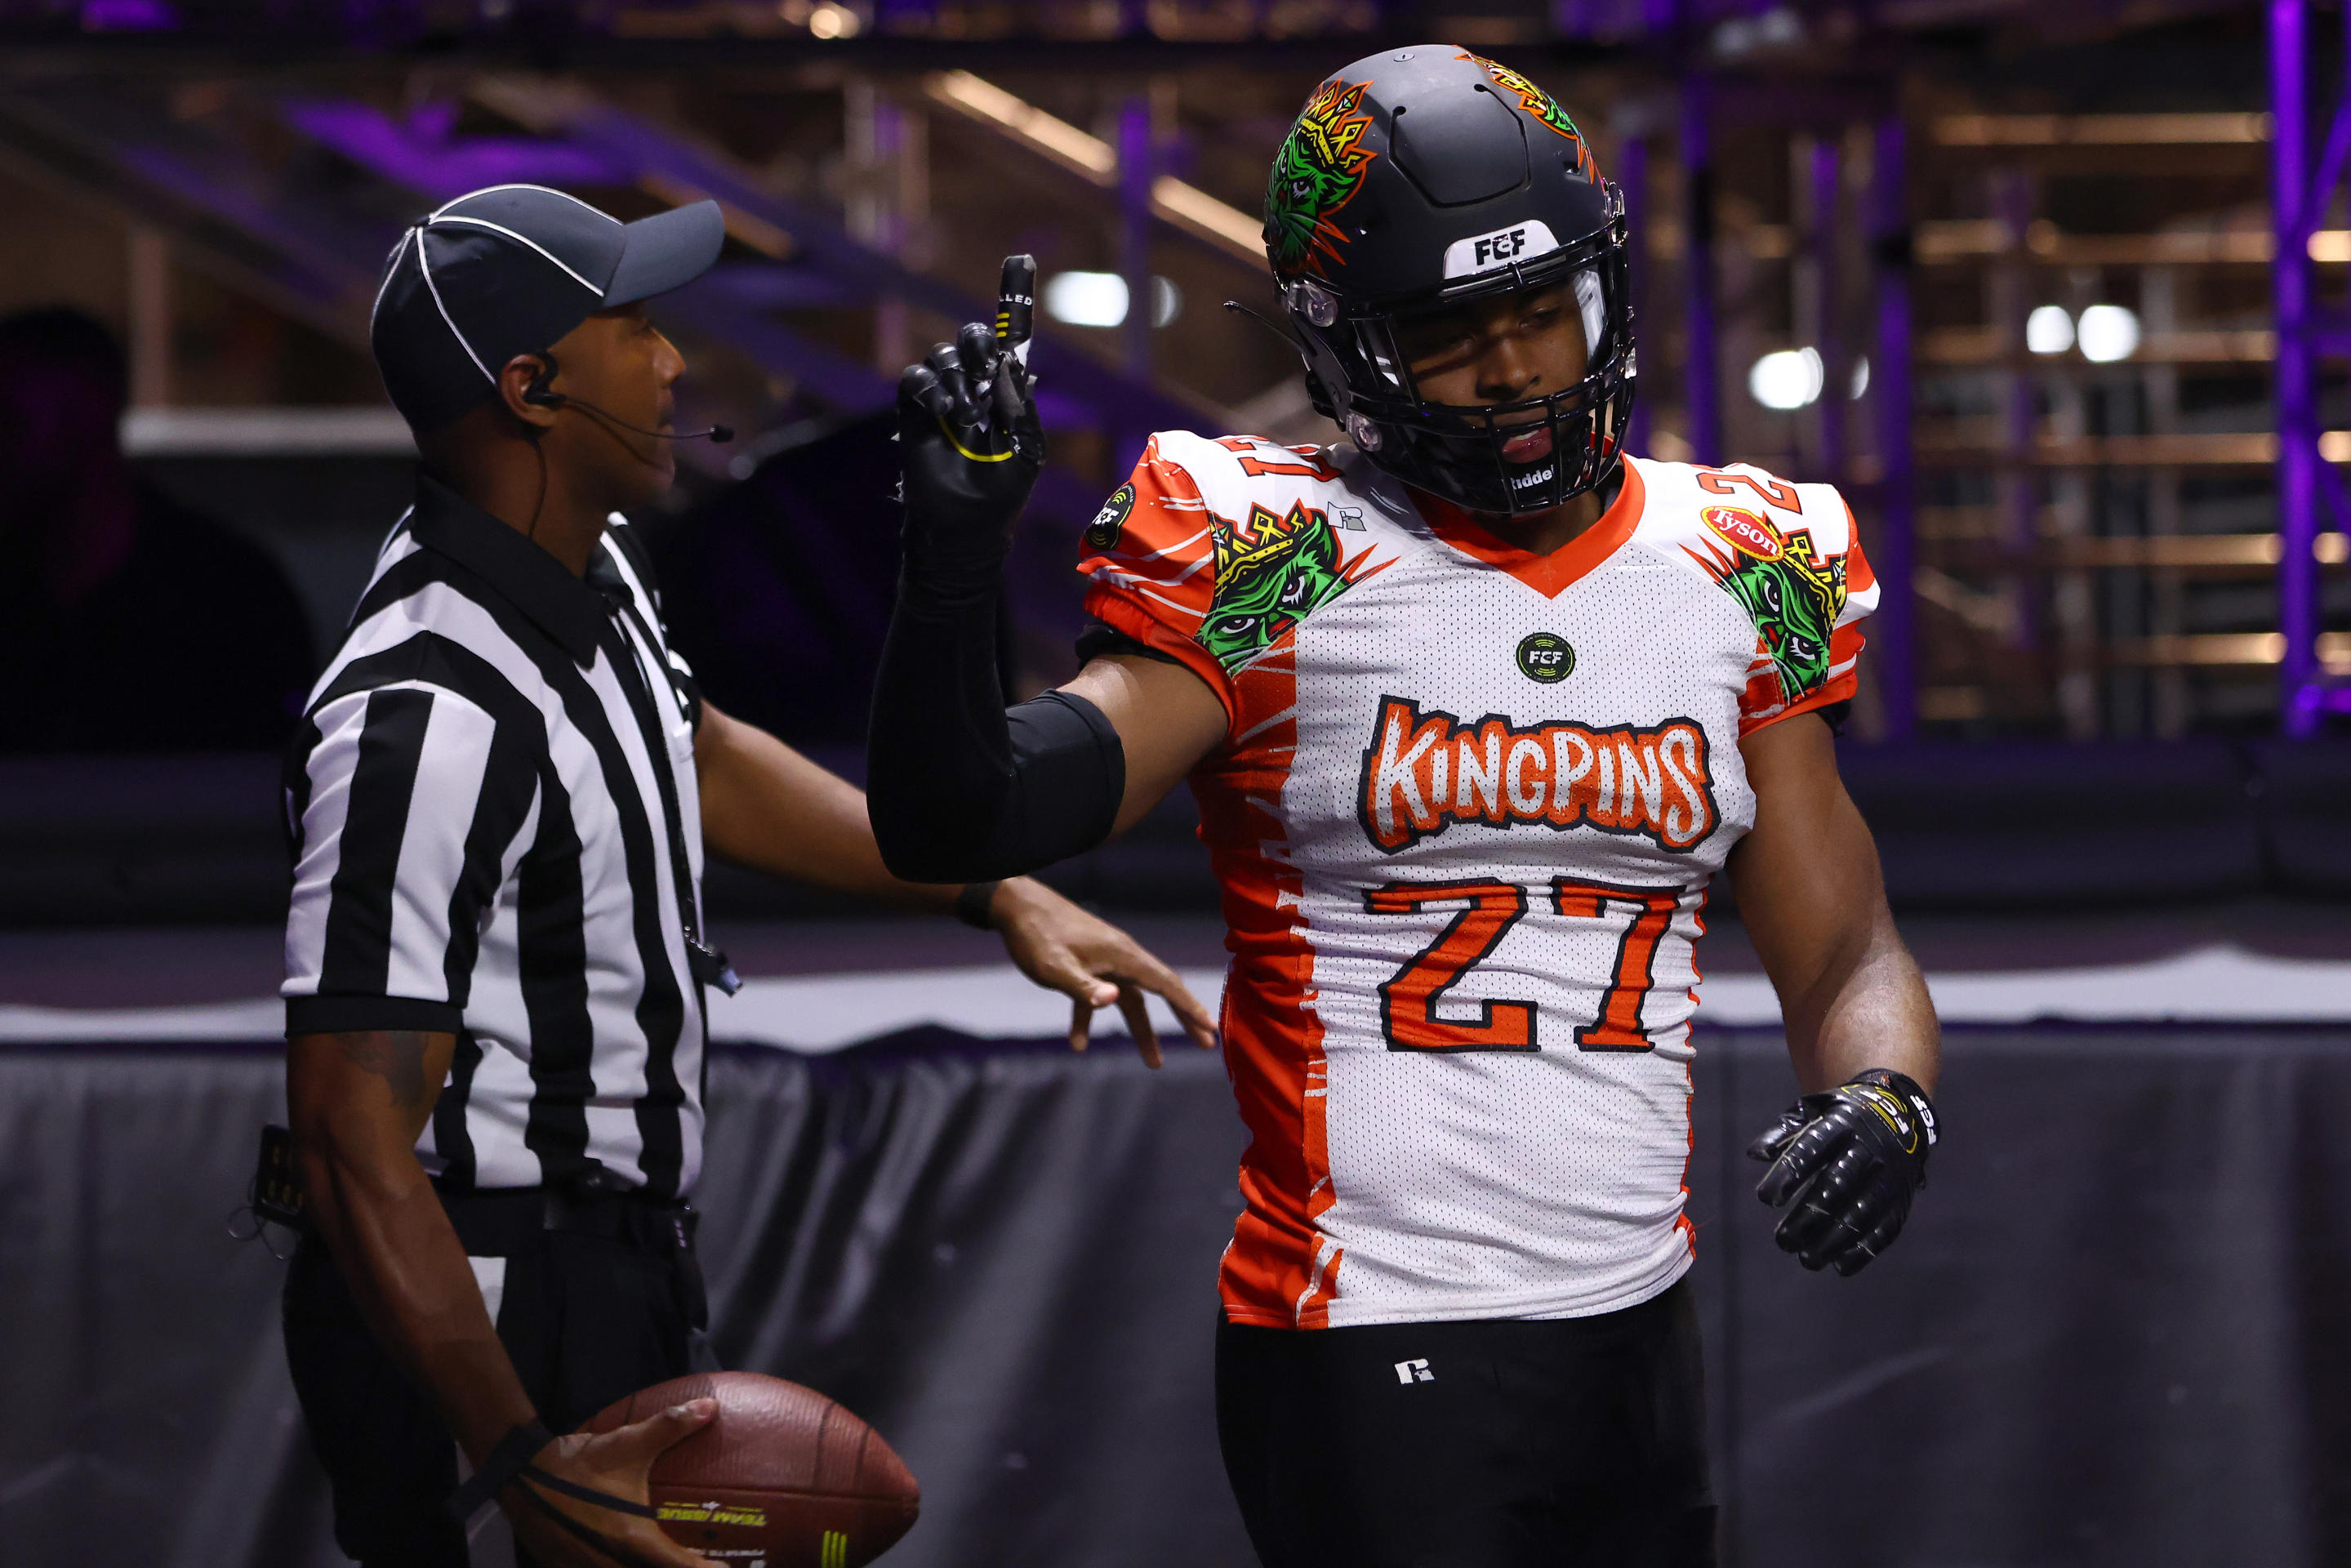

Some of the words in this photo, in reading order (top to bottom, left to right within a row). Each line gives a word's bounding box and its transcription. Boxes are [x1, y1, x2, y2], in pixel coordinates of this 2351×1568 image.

[1475, 229, 1525, 265] FCF
[1712, 507, 1779, 556] Tyson
[1529, 651, 1563, 664] FCF
[1365, 704, 1714, 849] KINGPINS
[1363, 875, 1686, 1052] 27
